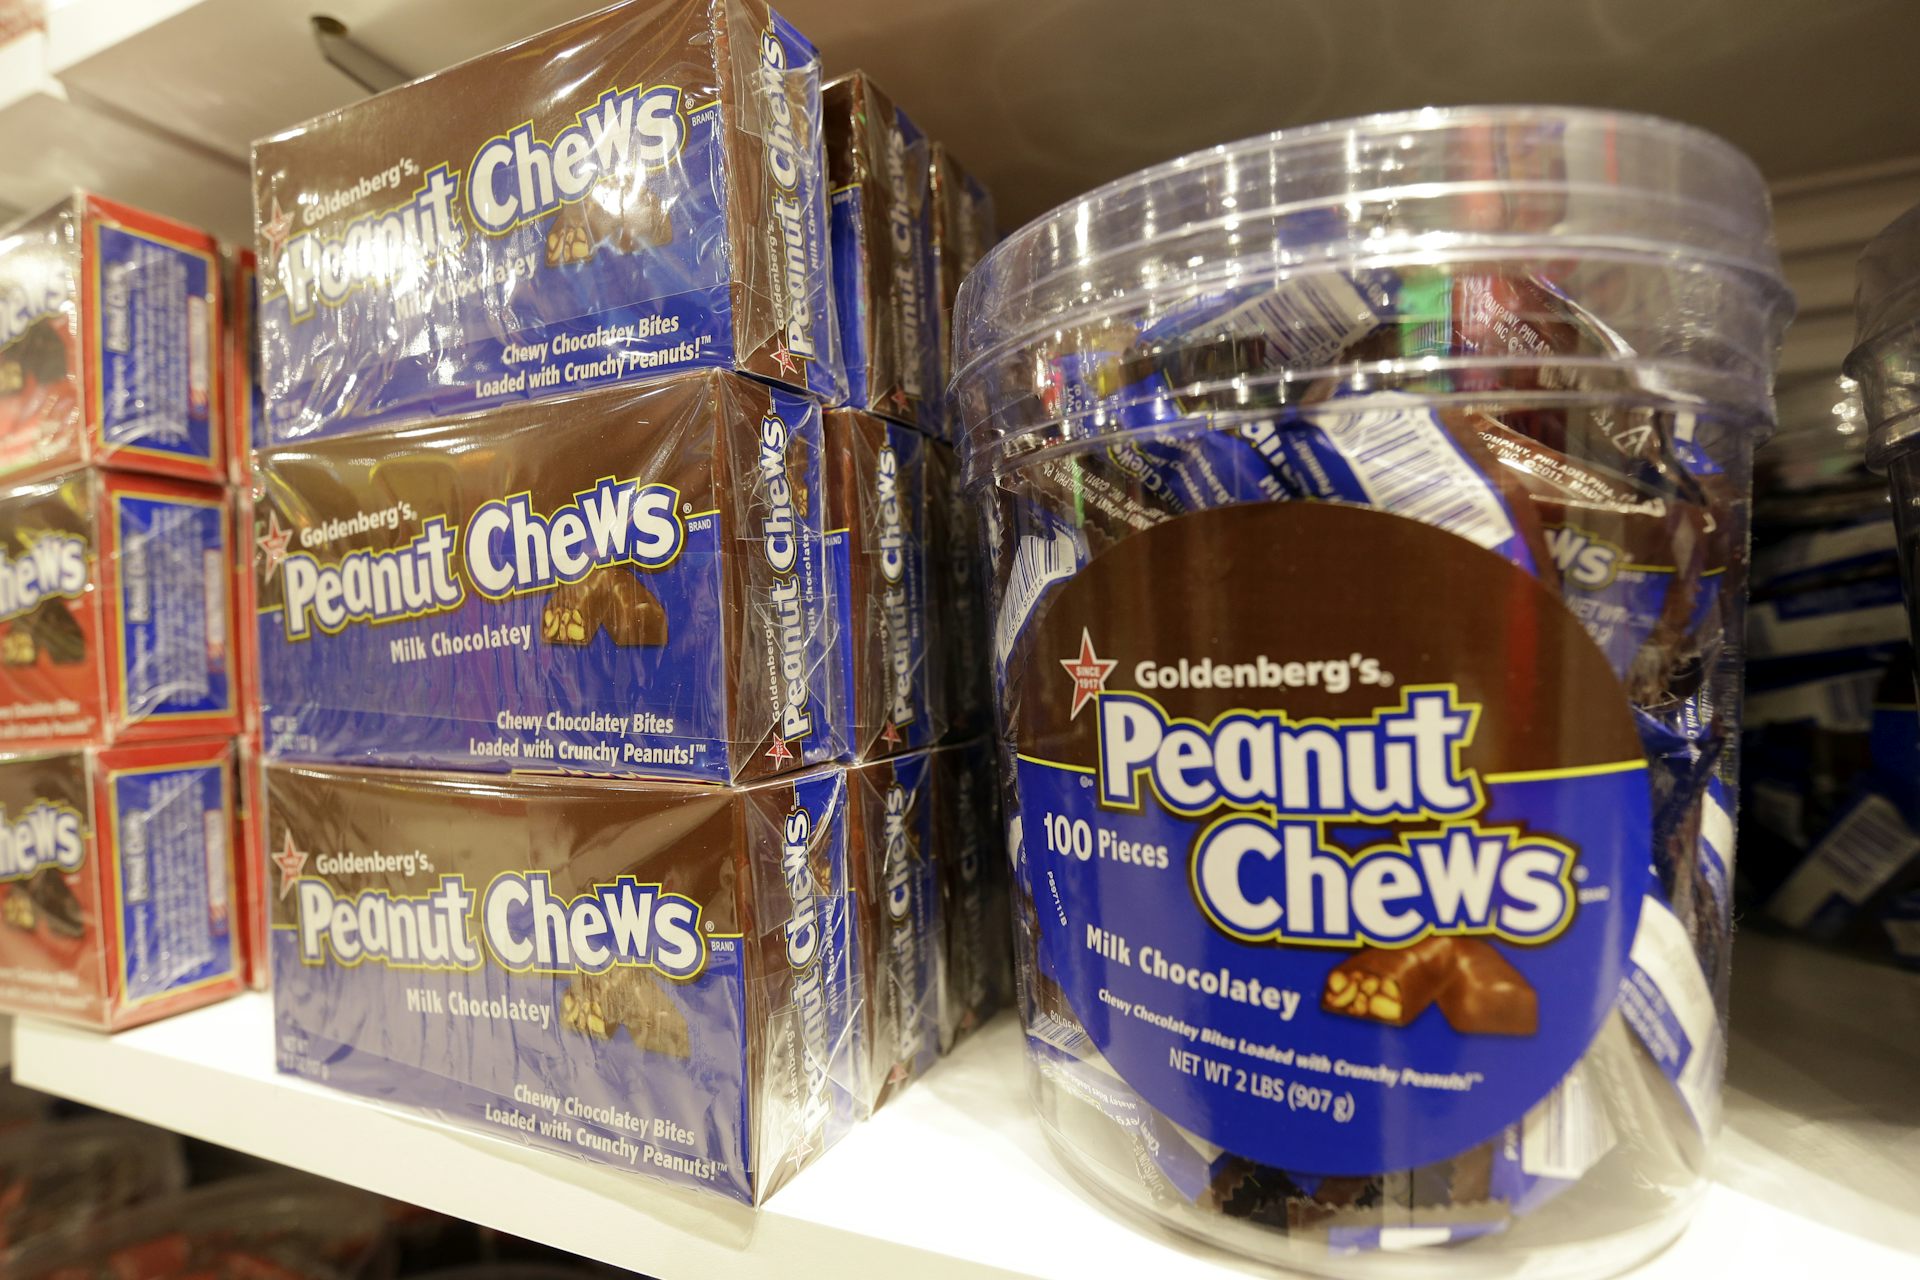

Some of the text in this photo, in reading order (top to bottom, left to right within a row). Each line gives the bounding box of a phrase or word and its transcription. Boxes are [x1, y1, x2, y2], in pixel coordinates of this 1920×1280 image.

[691, 109, 714, 127] BRAND
[303, 157, 415, 227] Goldenberg's
[289, 172, 459, 313] Peanut
[774, 196, 815, 356] Peanut
[501, 314, 679, 366] Chewy Chocolatey Bites
[475, 373, 527, 399] Loaded
[529, 365, 561, 389] with
[564, 354, 626, 386] Crunchy
[300, 501, 414, 549] Goldenberg's
[687, 517, 713, 533] BRAND
[825, 535, 843, 547] RAND
[0, 537, 86, 613] hews
[286, 526, 458, 634] Peanut
[467, 483, 678, 592] Chews
[762, 420, 809, 738] Peanut Chews
[390, 622, 532, 664] Milk Chocolatey
[883, 592, 914, 725] Peanut
[1076, 665, 1100, 677] SINCE
[1080, 678, 1099, 689] 1917
[1135, 653, 1381, 693] Goldenberg's
[469, 735, 522, 758] Loaded
[524, 736, 556, 759] with
[558, 739, 620, 767] Crunchy
[496, 710, 674, 739] Chewy Chocolatey Bites
[1103, 697, 1473, 811] Peanut
[0, 806, 82, 875] hews
[316, 850, 429, 878] Goldenberg's
[1044, 811, 1169, 869] 100 Pieces
[1201, 822, 1566, 941] Chews
[300, 876, 699, 970] Peanut Chews
[710, 939, 735, 953] BRAND
[1086, 923, 1301, 1022] Milk Chocolatey
[407, 987, 551, 1030] Milk Chocolatey
[1098, 988, 1132, 1021] Chewy
[1132, 1005, 1199, 1042] Chocolatey
[1200, 1028, 1236, 1053] Bites
[1239, 1040, 1294, 1067] Loaded
[1295, 1050, 1332, 1074] with
[1334, 1057, 1398, 1087] Crunchy
[794, 966, 830, 1131] Peanut
[1170, 1047, 1201, 1077] NET
[1205, 1058, 1232, 1085] WT
[1234, 1069, 1248, 1093] 2
[1251, 1075, 1285, 1105] LBS
[485, 1102, 537, 1133] Loaded
[538, 1116, 572, 1143] with
[575, 1124, 639, 1166] Crunchy
[513, 1083, 695, 1146] Chewy Chocolatey Bites
